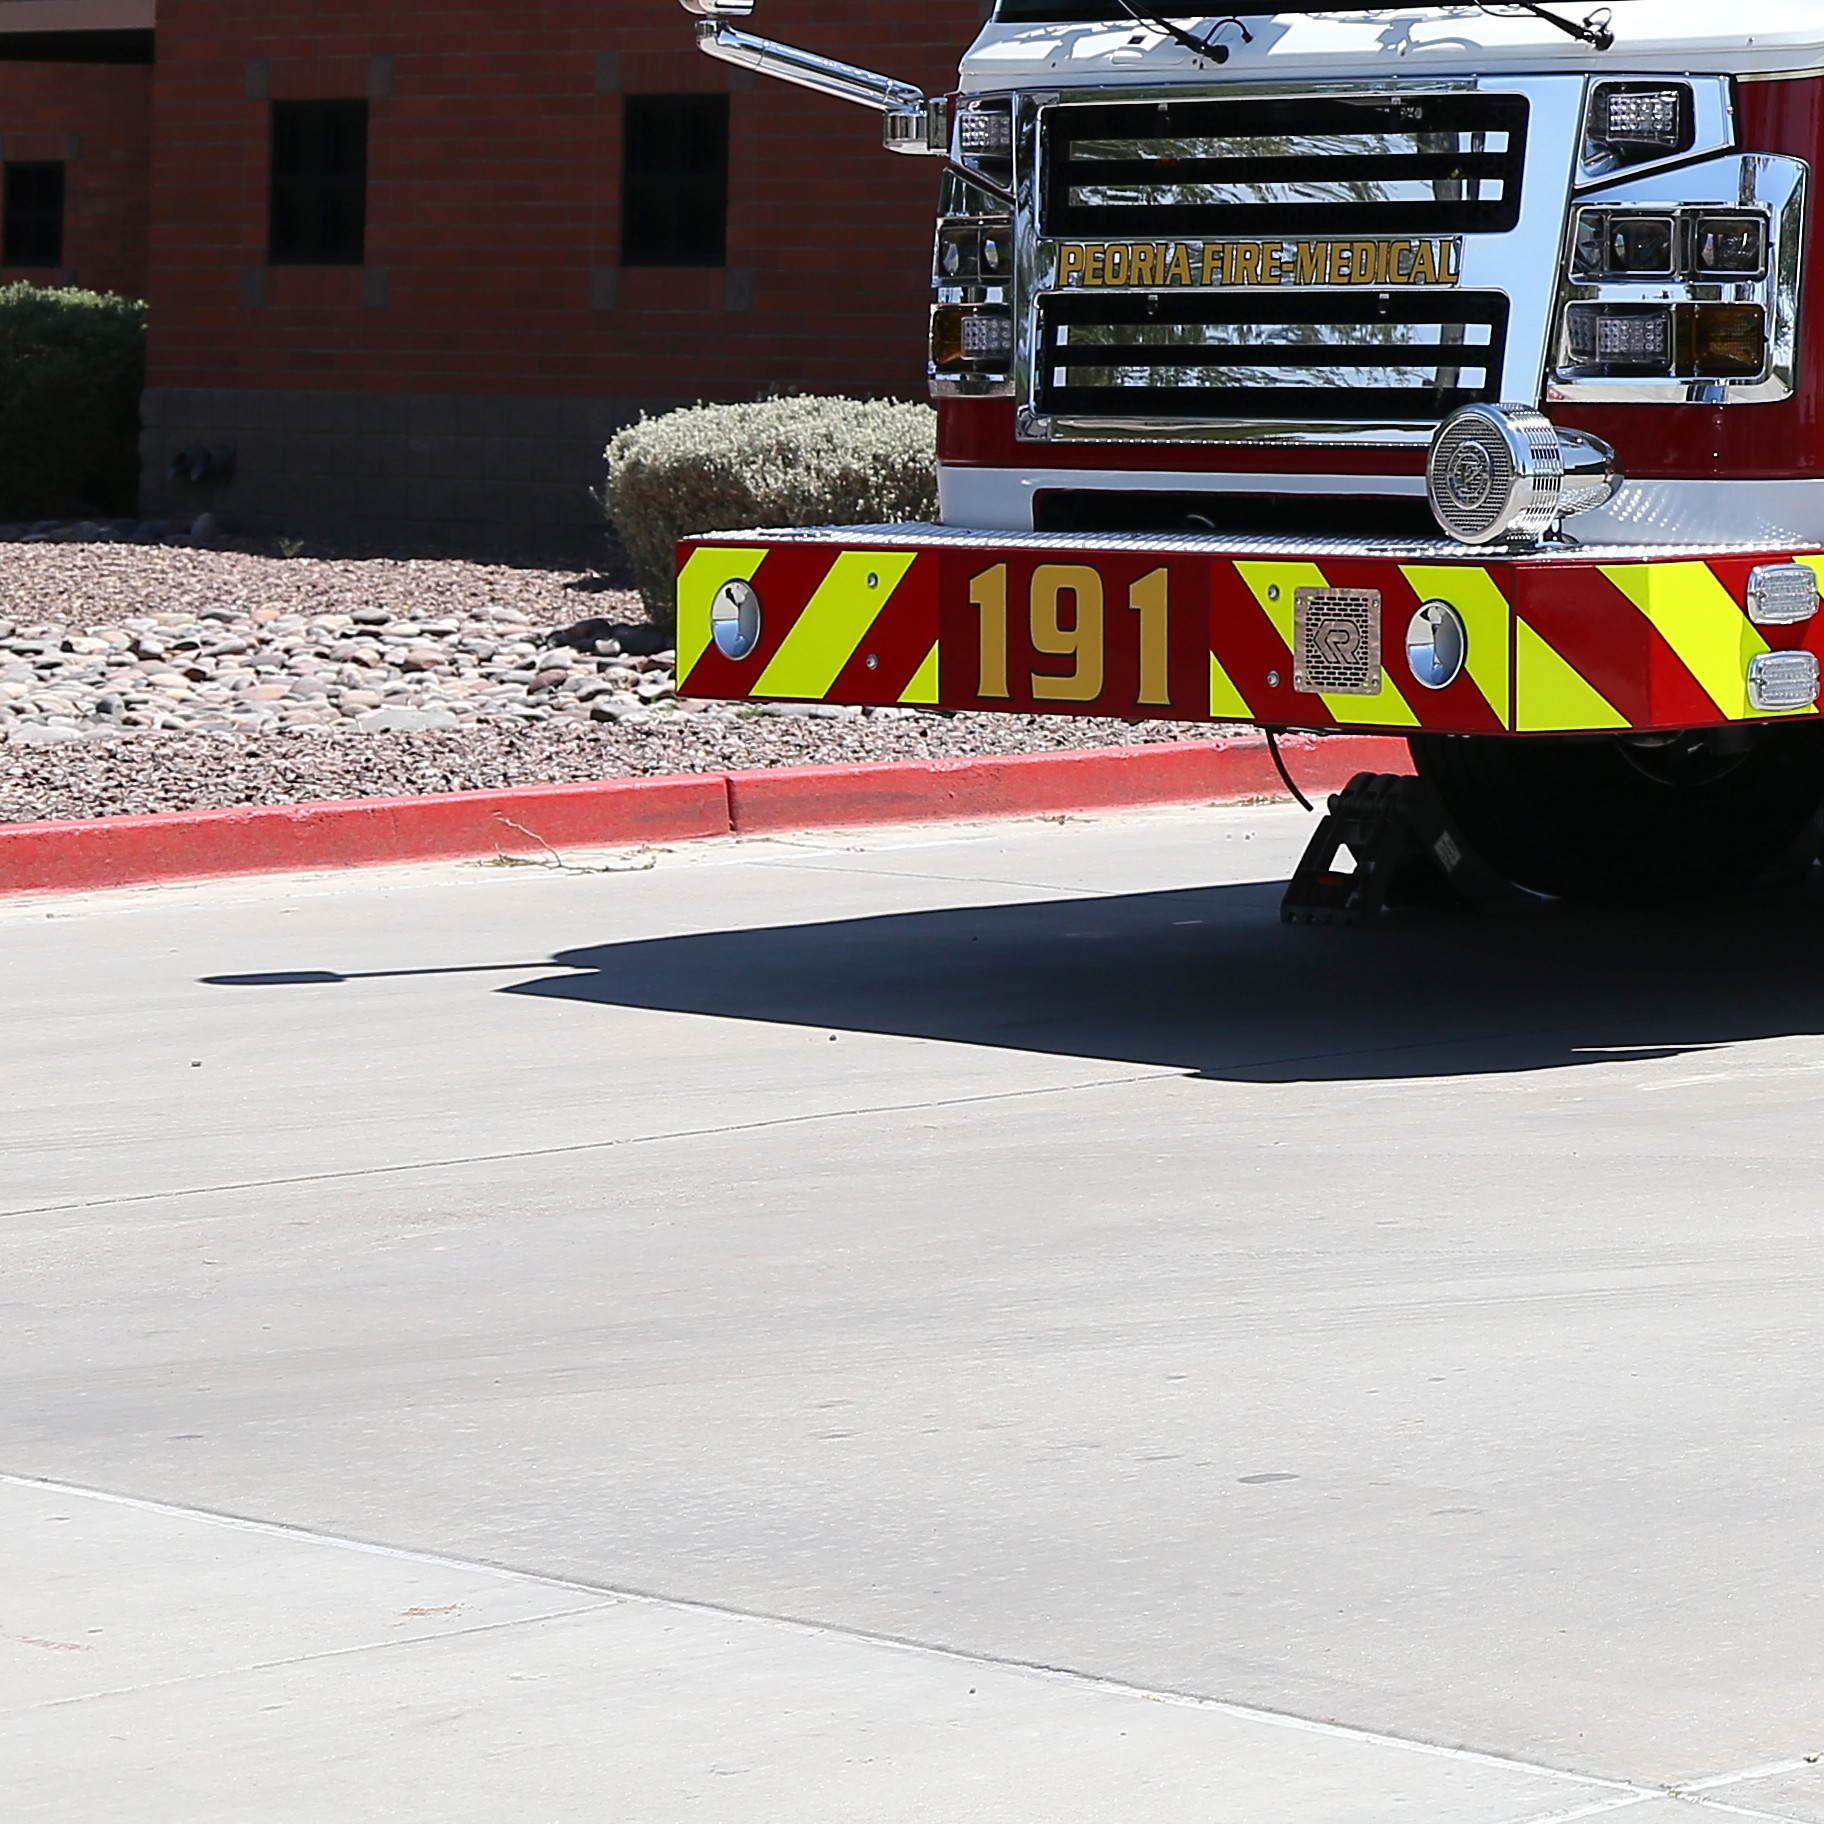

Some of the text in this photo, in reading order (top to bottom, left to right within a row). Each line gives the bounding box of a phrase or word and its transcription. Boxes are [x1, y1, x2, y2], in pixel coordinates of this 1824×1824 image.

[1058, 239, 1460, 287] PEORIA FIRE-MEDICAL
[967, 562, 1172, 708] 191
